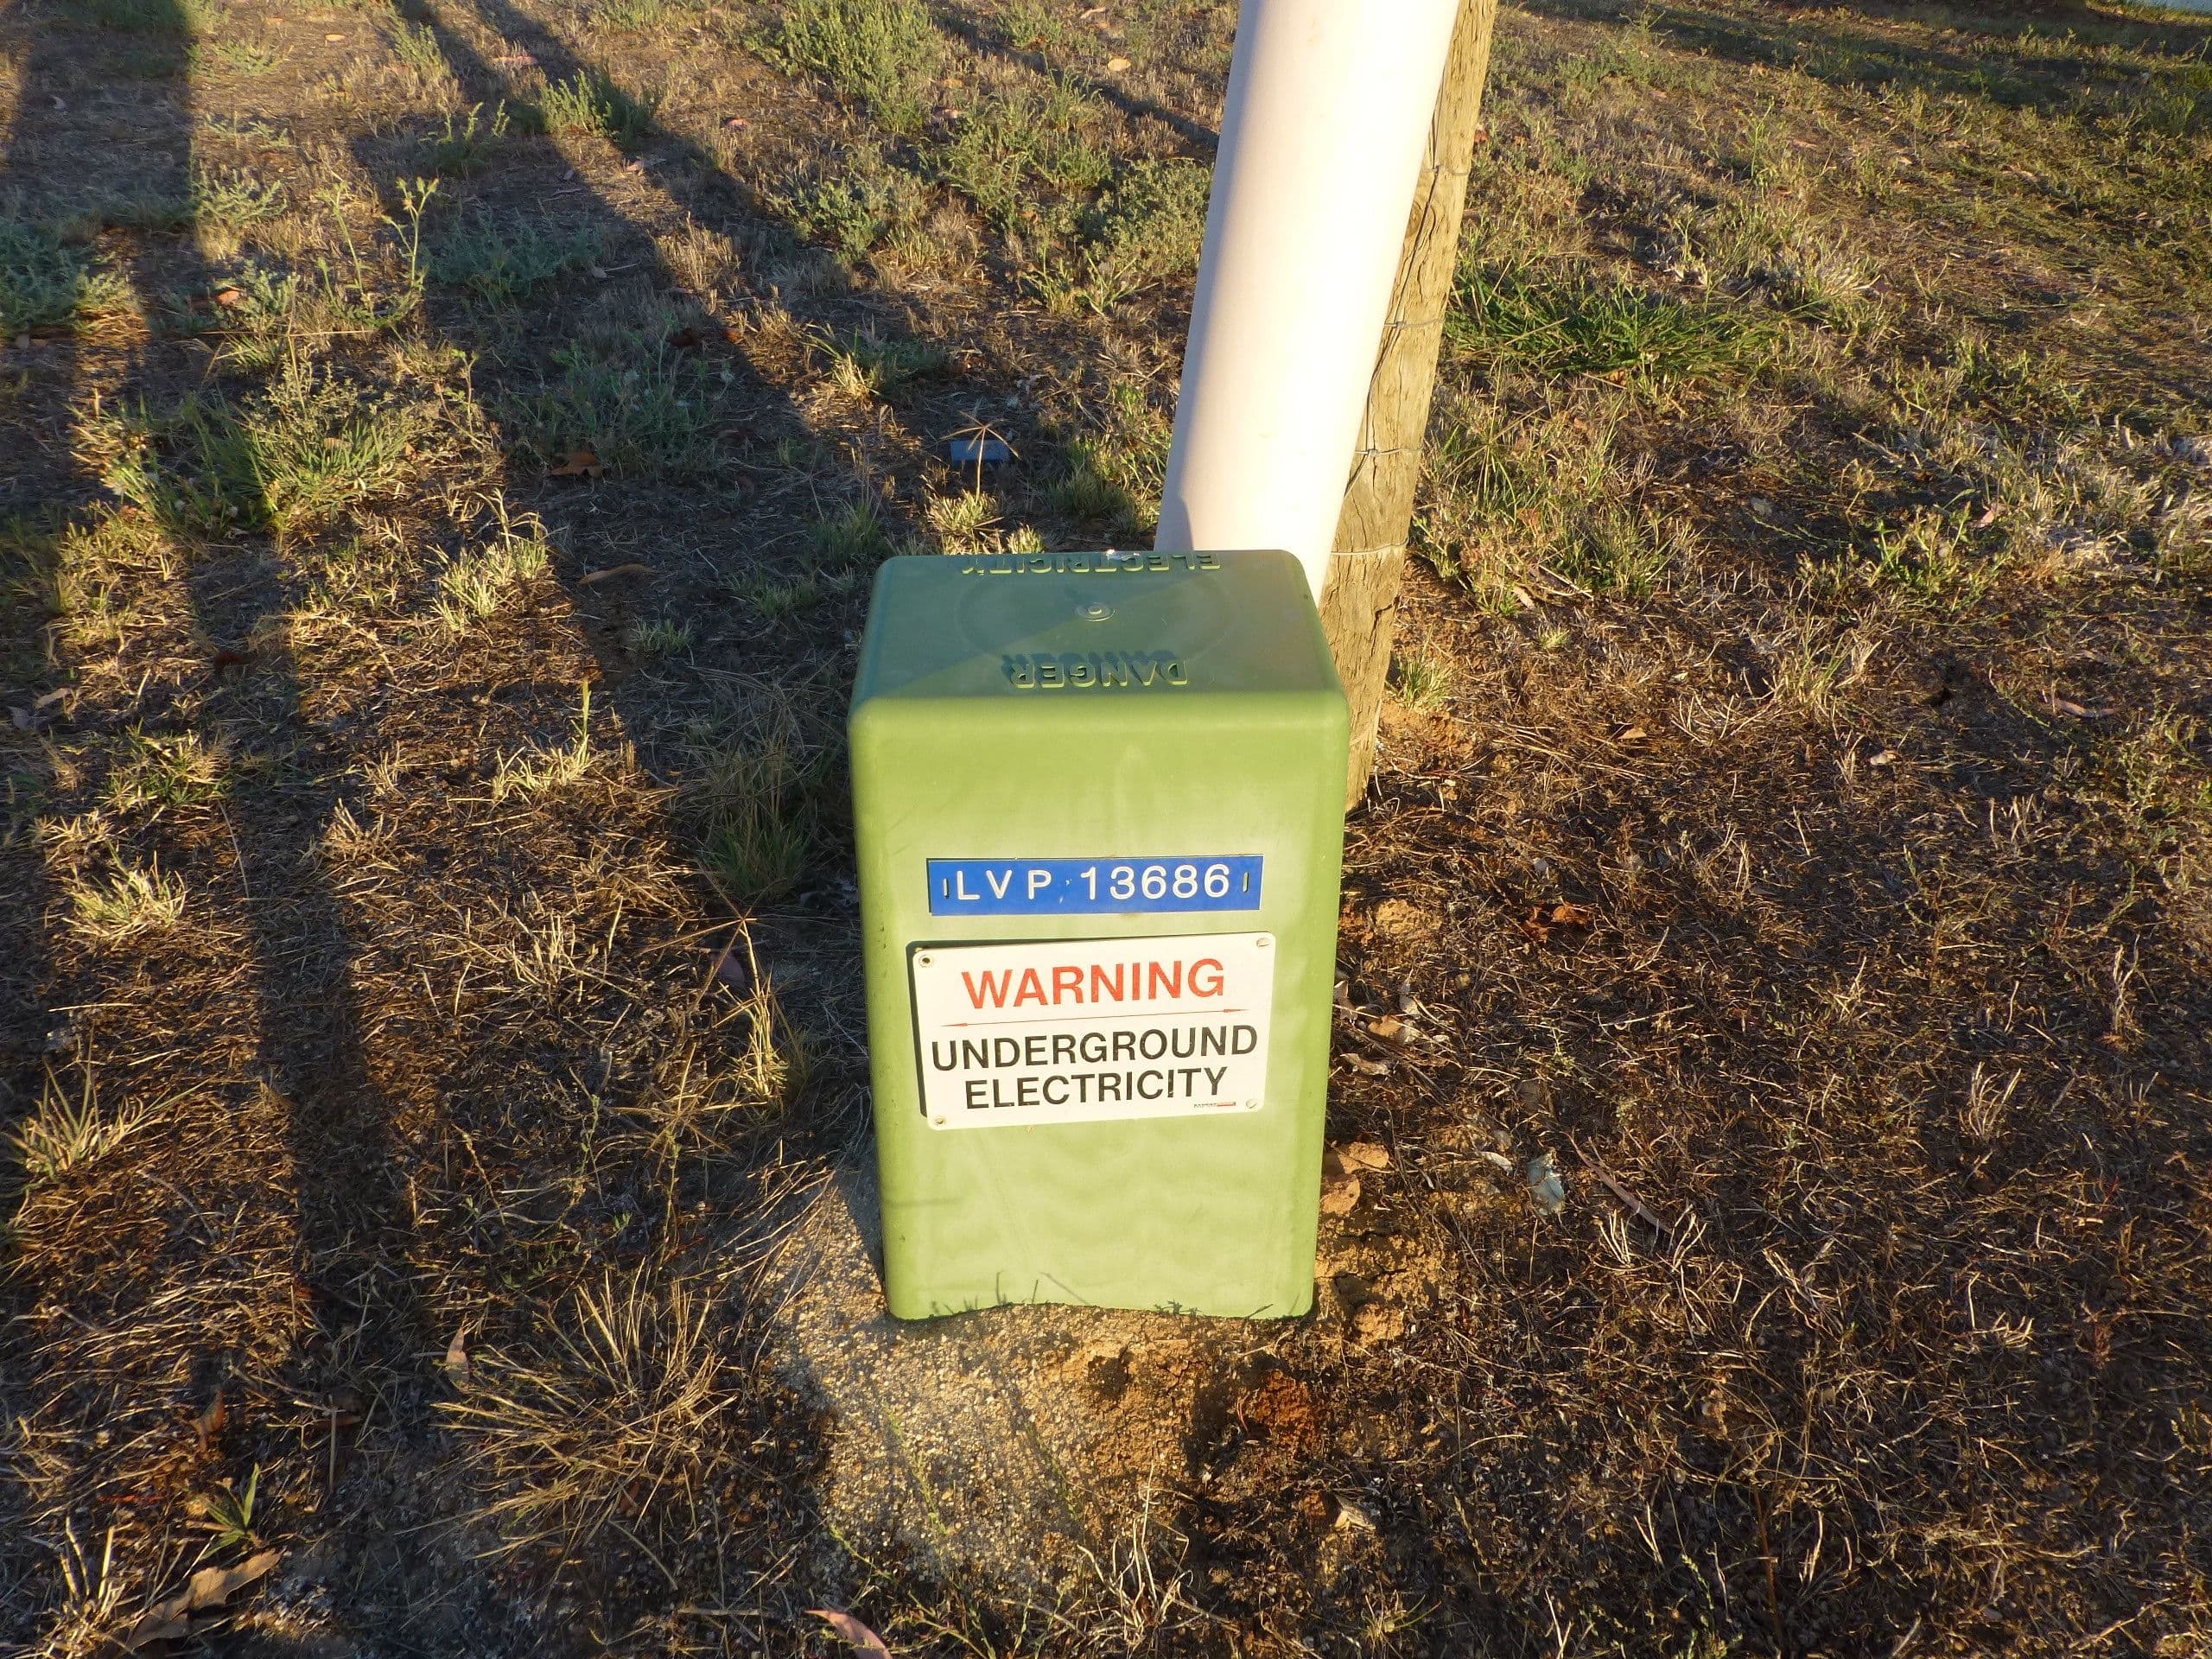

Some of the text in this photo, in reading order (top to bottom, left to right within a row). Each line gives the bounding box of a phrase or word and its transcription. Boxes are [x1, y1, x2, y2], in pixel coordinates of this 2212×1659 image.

[961, 553, 1222, 575] ELECTRICITY
[1009, 659, 1189, 689] DANGER
[1080, 863, 1231, 901] 13686
[961, 957, 1224, 1010] WARNING
[931, 1024, 1258, 1071] UNDERGROUND
[964, 1066, 1228, 1110] ELECTRICITY
